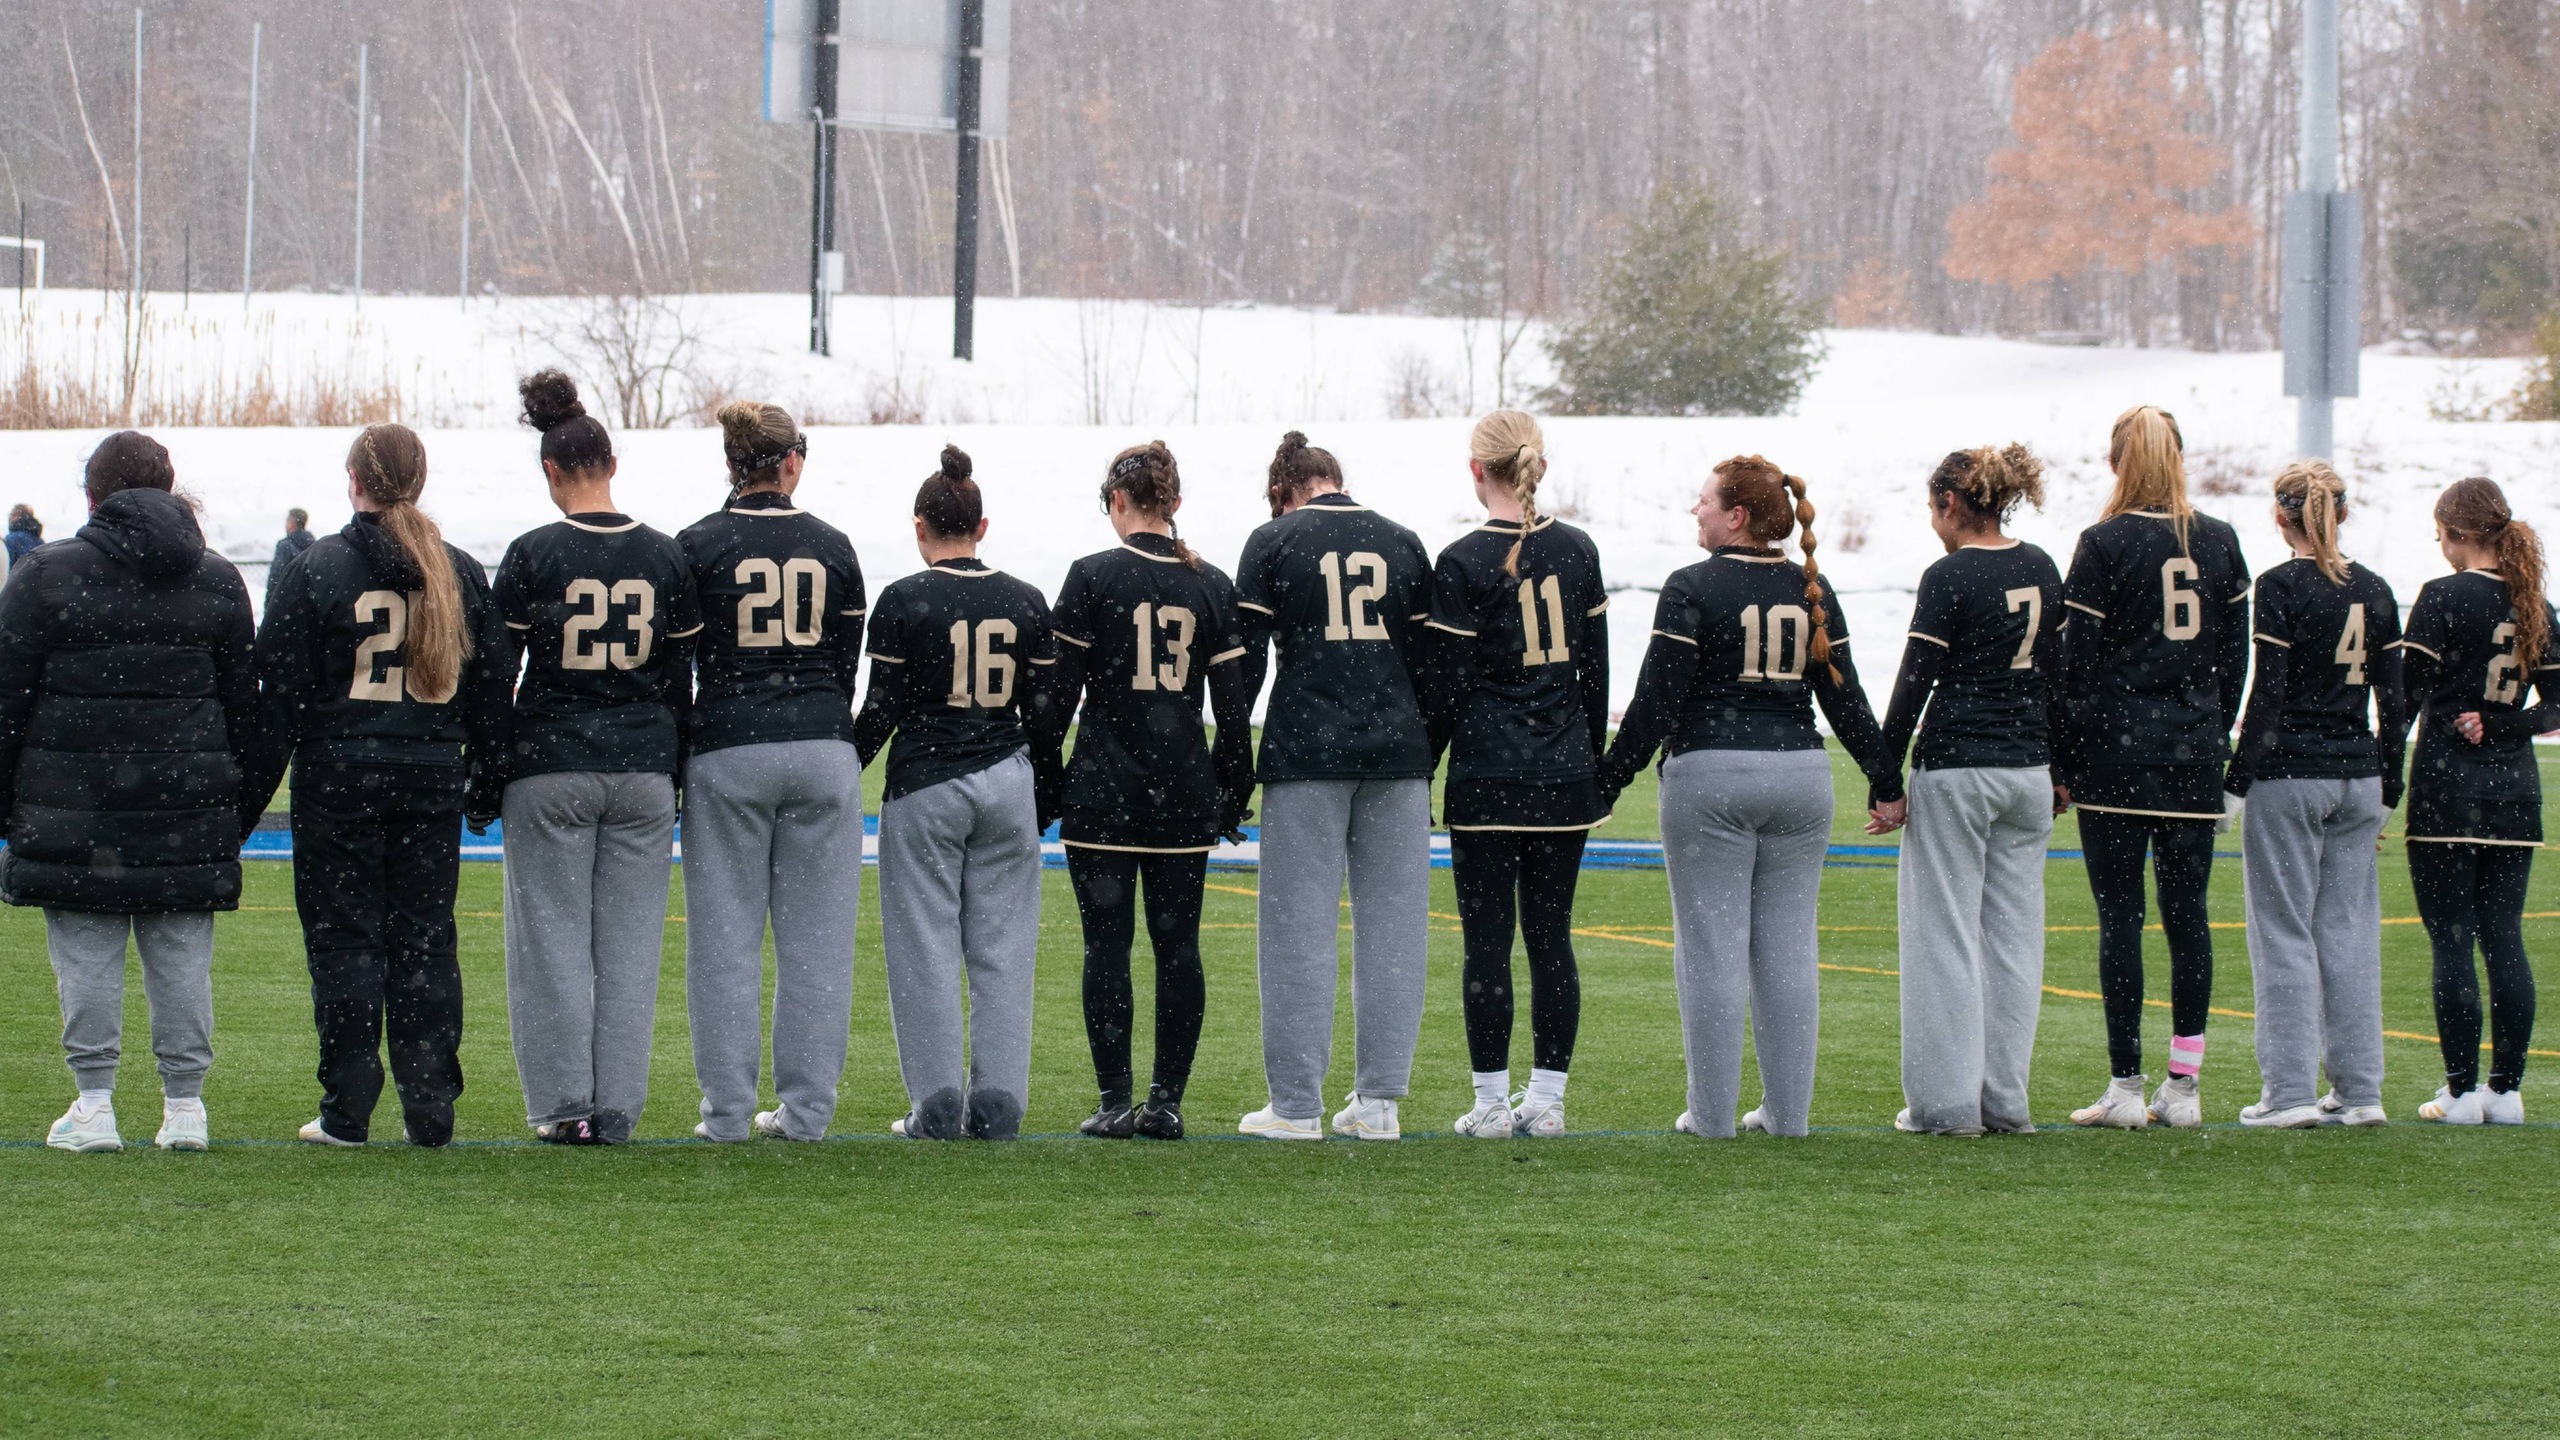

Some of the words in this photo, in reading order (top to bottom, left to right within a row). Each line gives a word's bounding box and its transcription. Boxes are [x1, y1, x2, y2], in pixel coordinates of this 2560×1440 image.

[562, 578, 656, 671] 23
[735, 557, 827, 648] 20
[1320, 551, 1390, 641] 12
[1518, 574, 1571, 667] 11
[2005, 586, 2042, 670] 7
[2161, 557, 2202, 641] 6
[947, 618, 1018, 709] 16
[1132, 602, 1197, 692] 13
[1736, 603, 1810, 683] 10
[2335, 603, 2368, 685] 4
[2484, 621, 2522, 704] 2
[577, 1120, 591, 1138] 2
